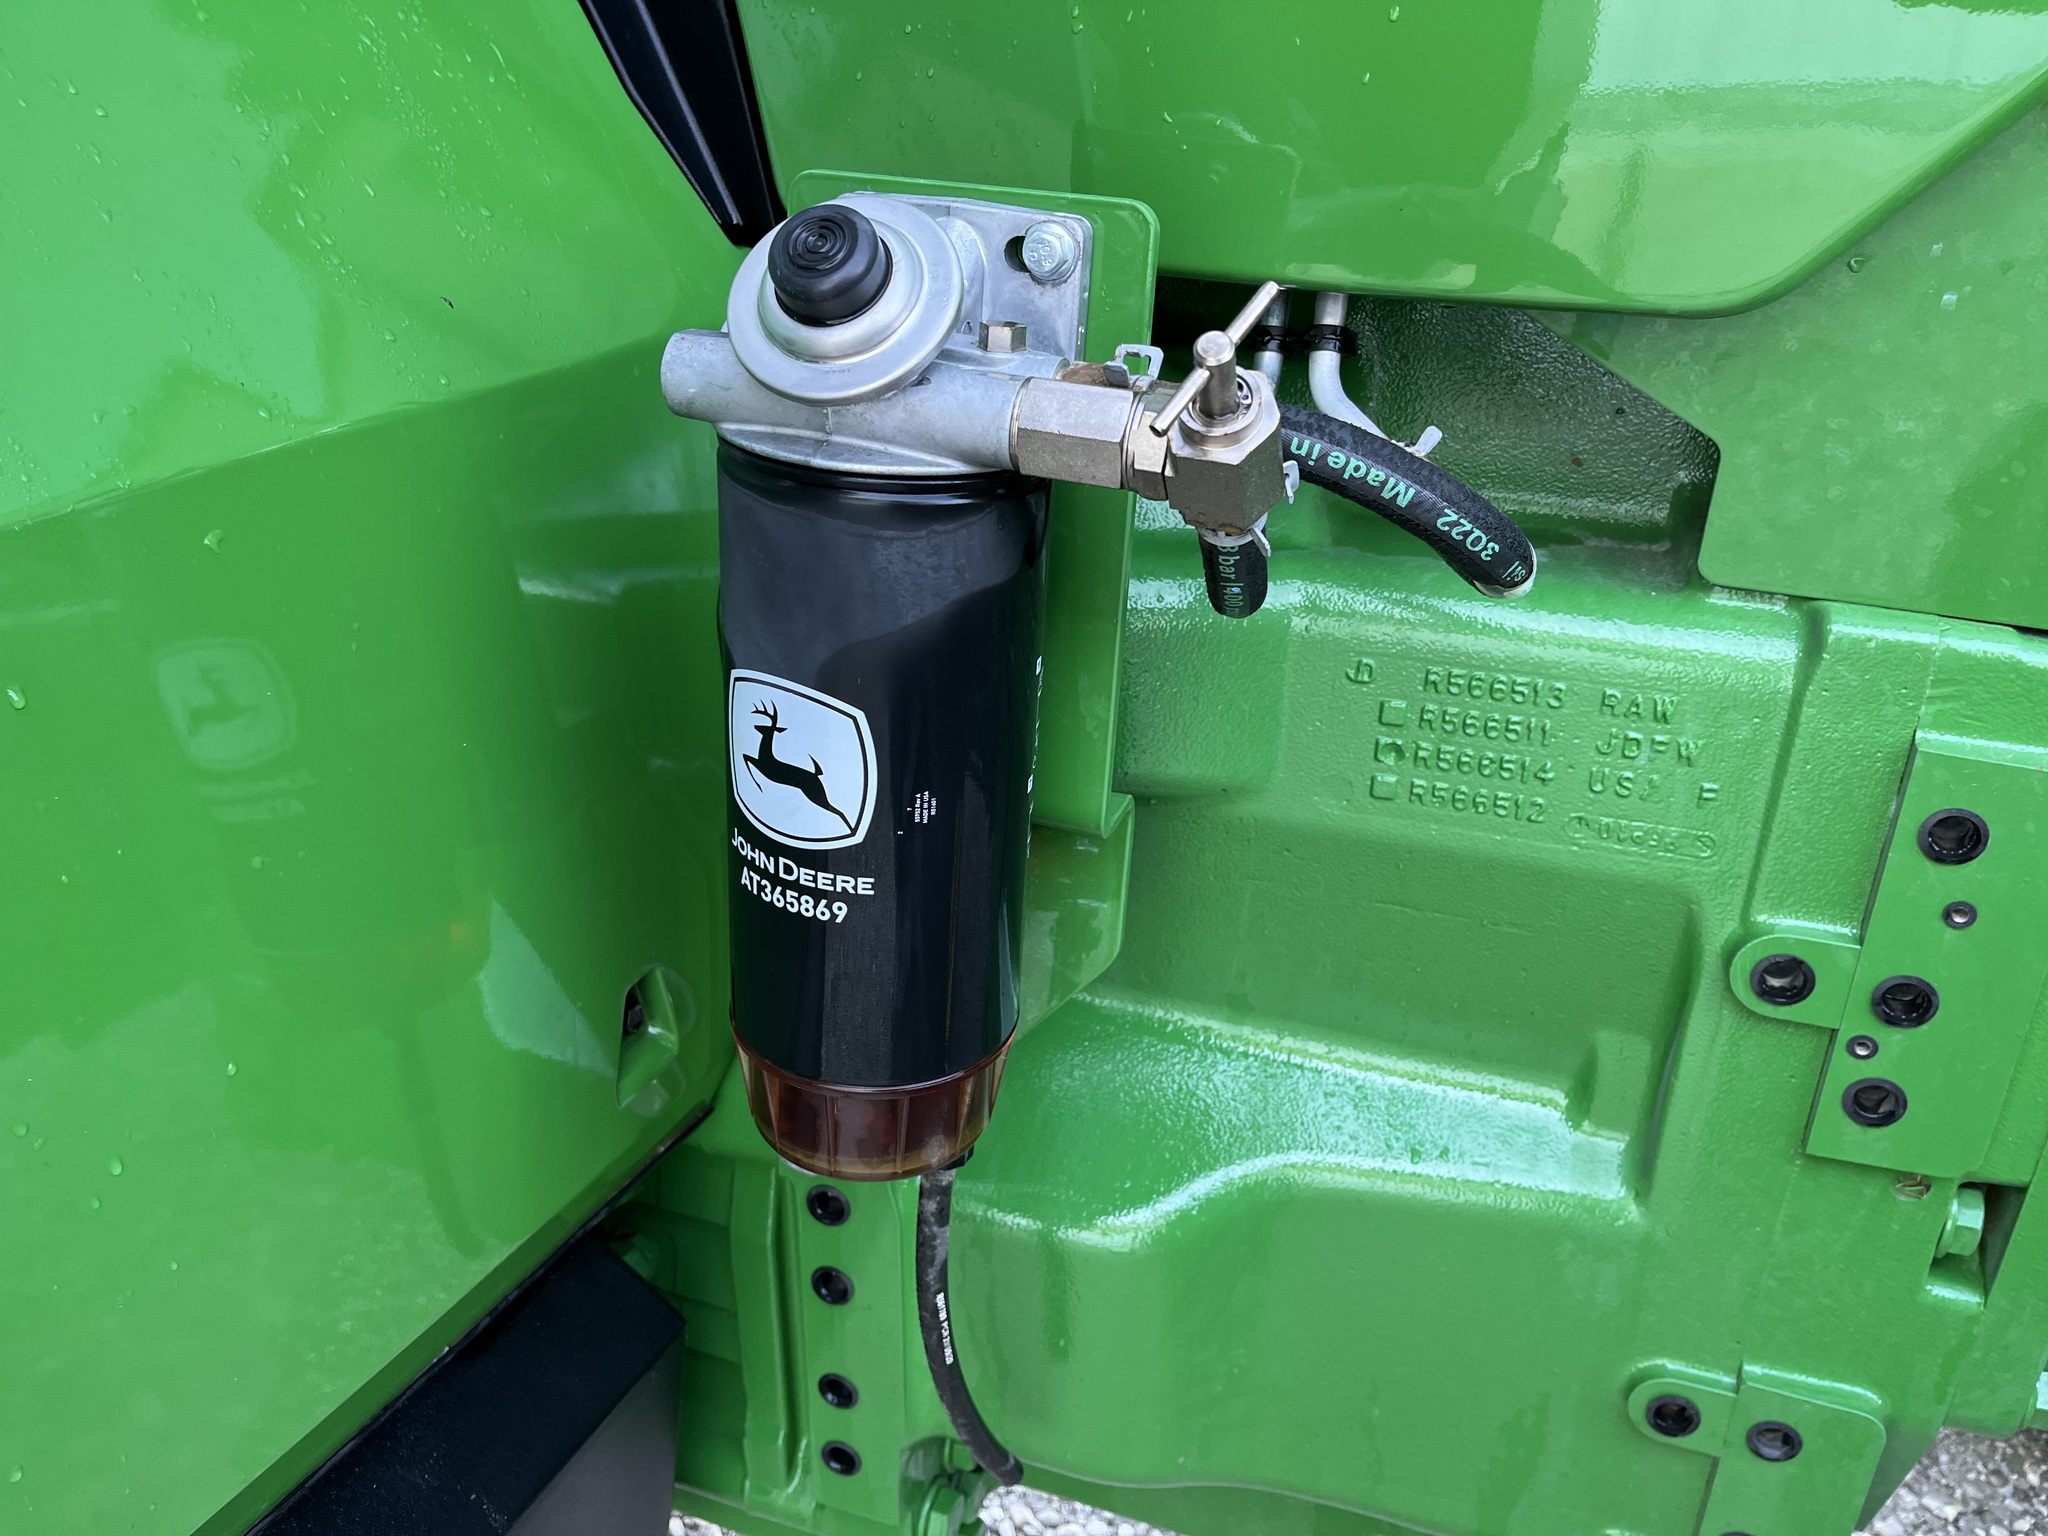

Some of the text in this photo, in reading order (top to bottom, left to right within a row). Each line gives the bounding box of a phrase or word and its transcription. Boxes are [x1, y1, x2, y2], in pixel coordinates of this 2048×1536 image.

[1290, 436, 1322, 466] in
[1327, 451, 1417, 509] Made
[1218, 555, 1240, 580] bar
[1424, 666, 1678, 725] R566513 RAW
[1418, 702, 1551, 747] R566511
[1412, 740, 1556, 786] R566514
[1408, 777, 1549, 824] R566512
[731, 827, 875, 895] JOHN DEERE
[740, 866, 848, 923] AT365869
